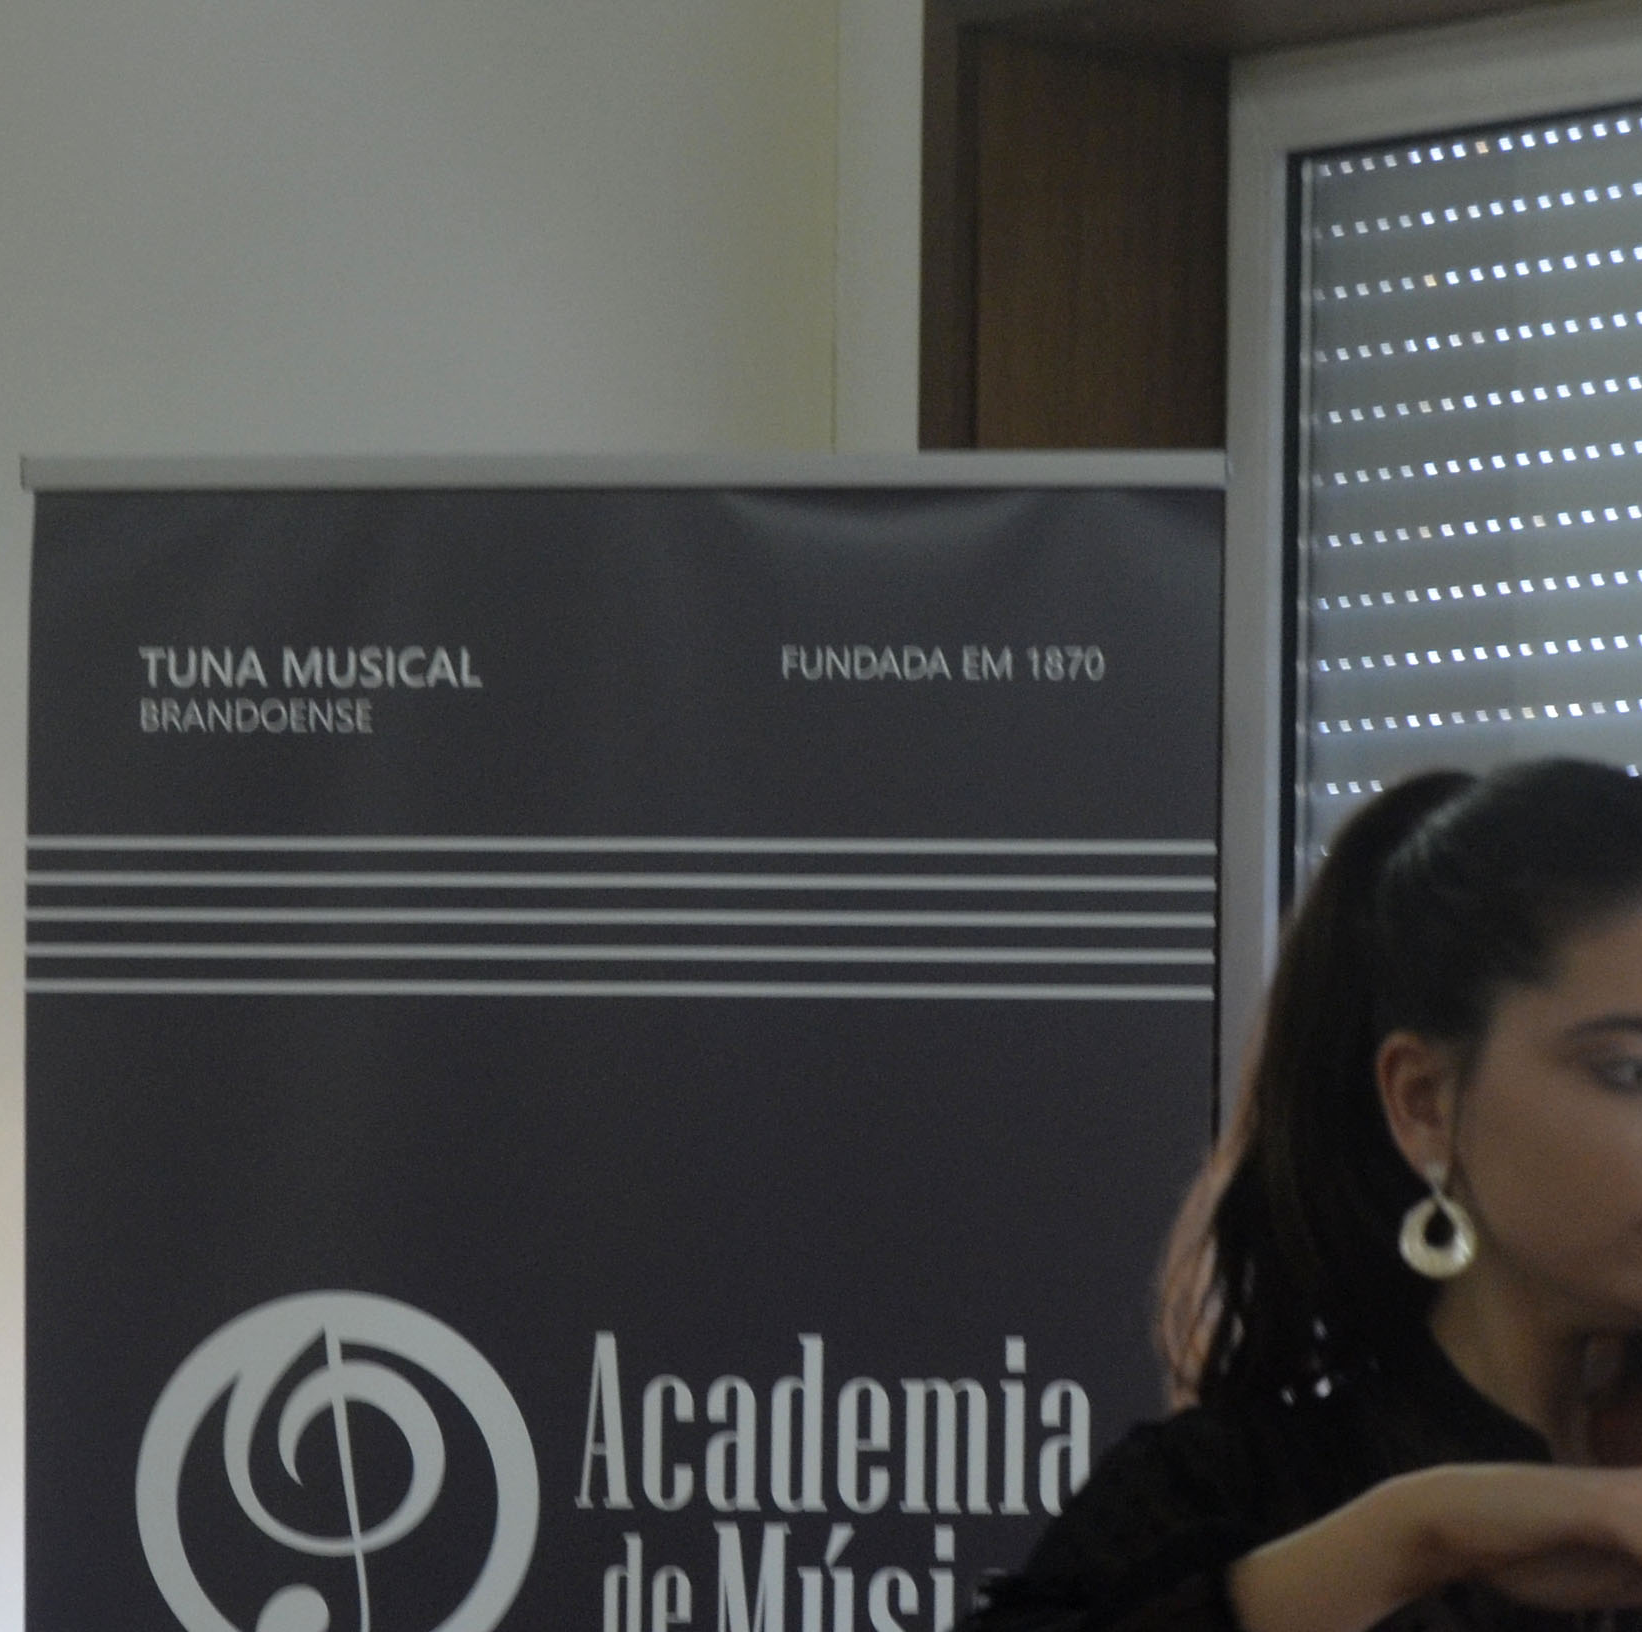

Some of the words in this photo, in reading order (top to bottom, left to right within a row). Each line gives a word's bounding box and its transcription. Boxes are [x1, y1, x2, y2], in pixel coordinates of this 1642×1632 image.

[138, 645, 269, 690] TUNA
[281, 645, 484, 690] MUSICAL
[780, 644, 953, 683] FUNDADA
[961, 644, 1014, 683] EM
[1026, 644, 1108, 683] 1870
[138, 696, 374, 735] BRANDOENSE
[574, 1330, 1093, 1517] Academia
